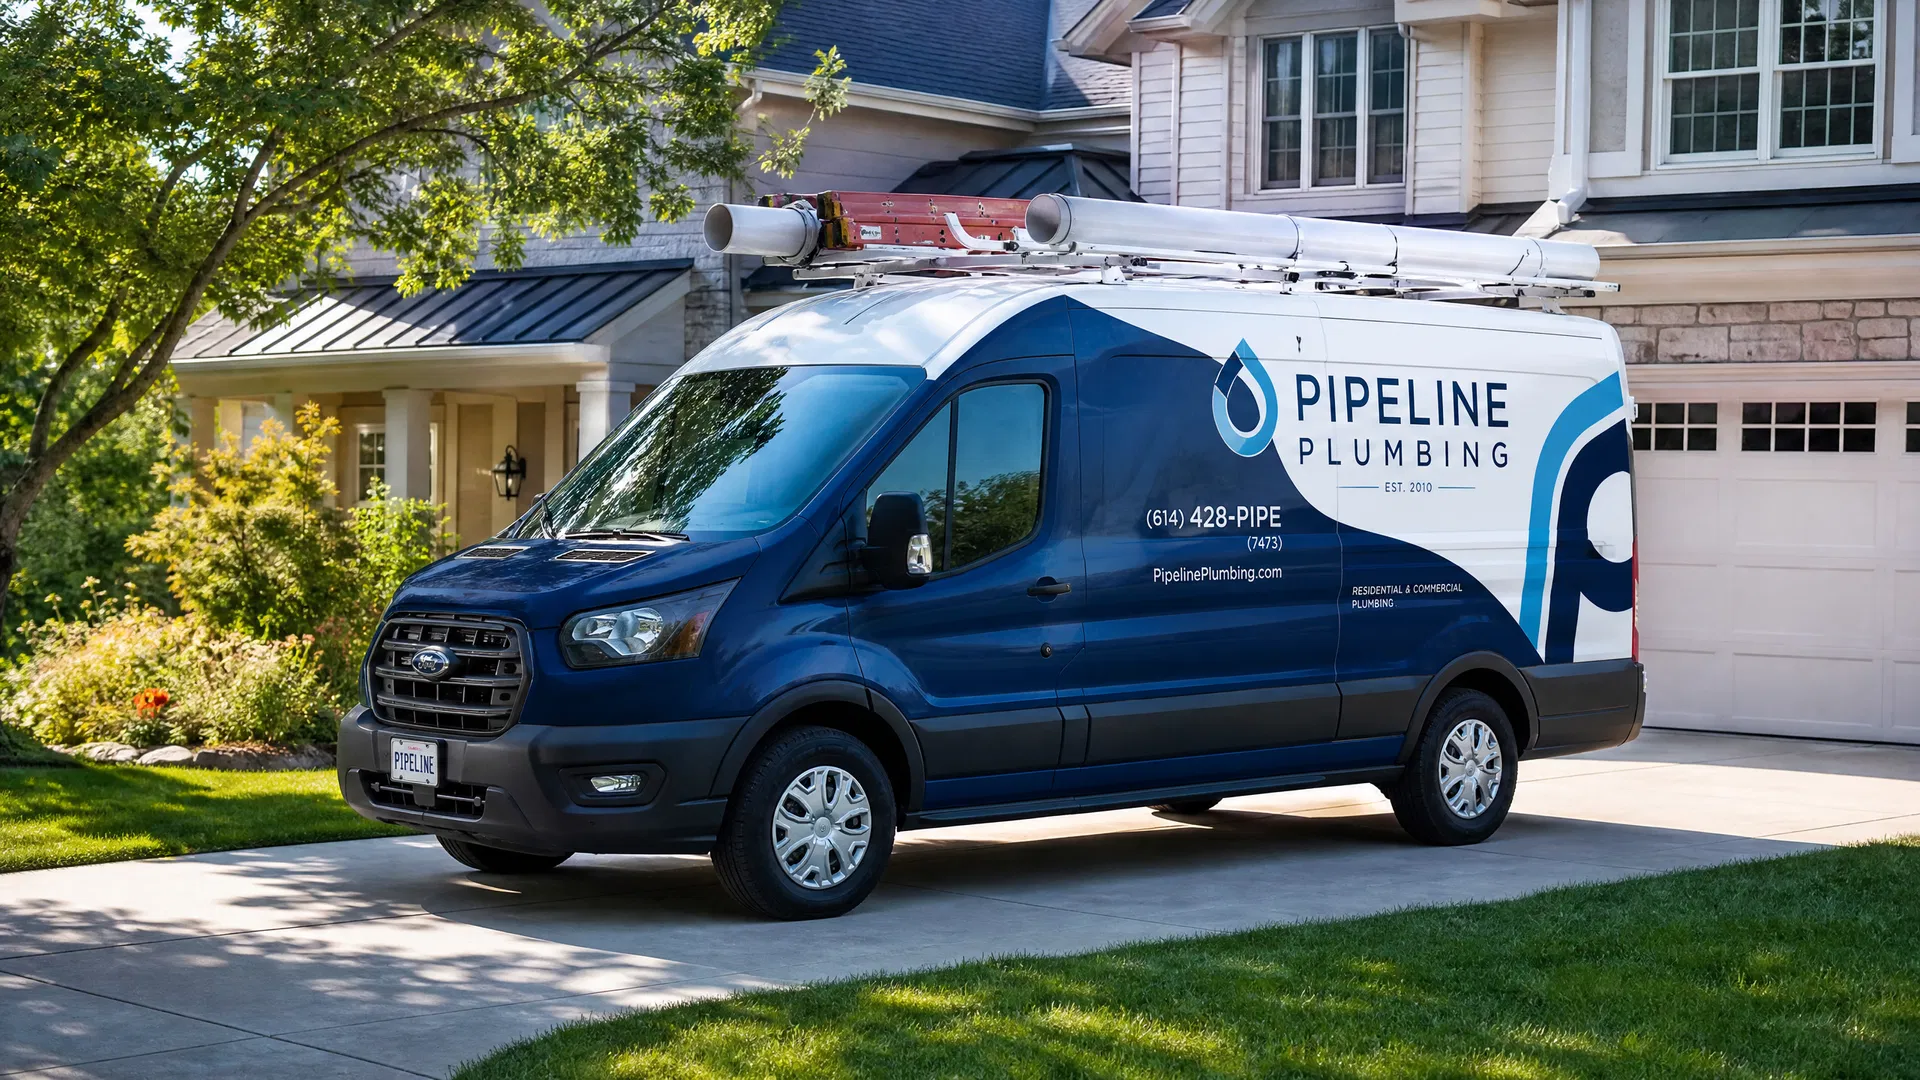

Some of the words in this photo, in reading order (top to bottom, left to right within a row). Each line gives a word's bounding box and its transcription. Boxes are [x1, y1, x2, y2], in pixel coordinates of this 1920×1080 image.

[1296, 374, 1509, 427] PIPELINE
[1299, 437, 1508, 468] PLUMBING
[1384, 482, 1406, 492] EST.
[1410, 482, 1432, 492] 2010
[1146, 509, 1185, 529] (614)
[1190, 506, 1282, 528] 428-PIPE
[1247, 536, 1283, 551] (7473)
[1153, 566, 1282, 585] PipelinePlumbing.com
[1352, 585, 1403, 596] RESIDENTIAL
[1405, 585, 1411, 594] &
[1413, 583, 1463, 593] COMMERCIAL
[1352, 599, 1394, 609] PLUMBING
[394, 751, 434, 775] PIPELINE
